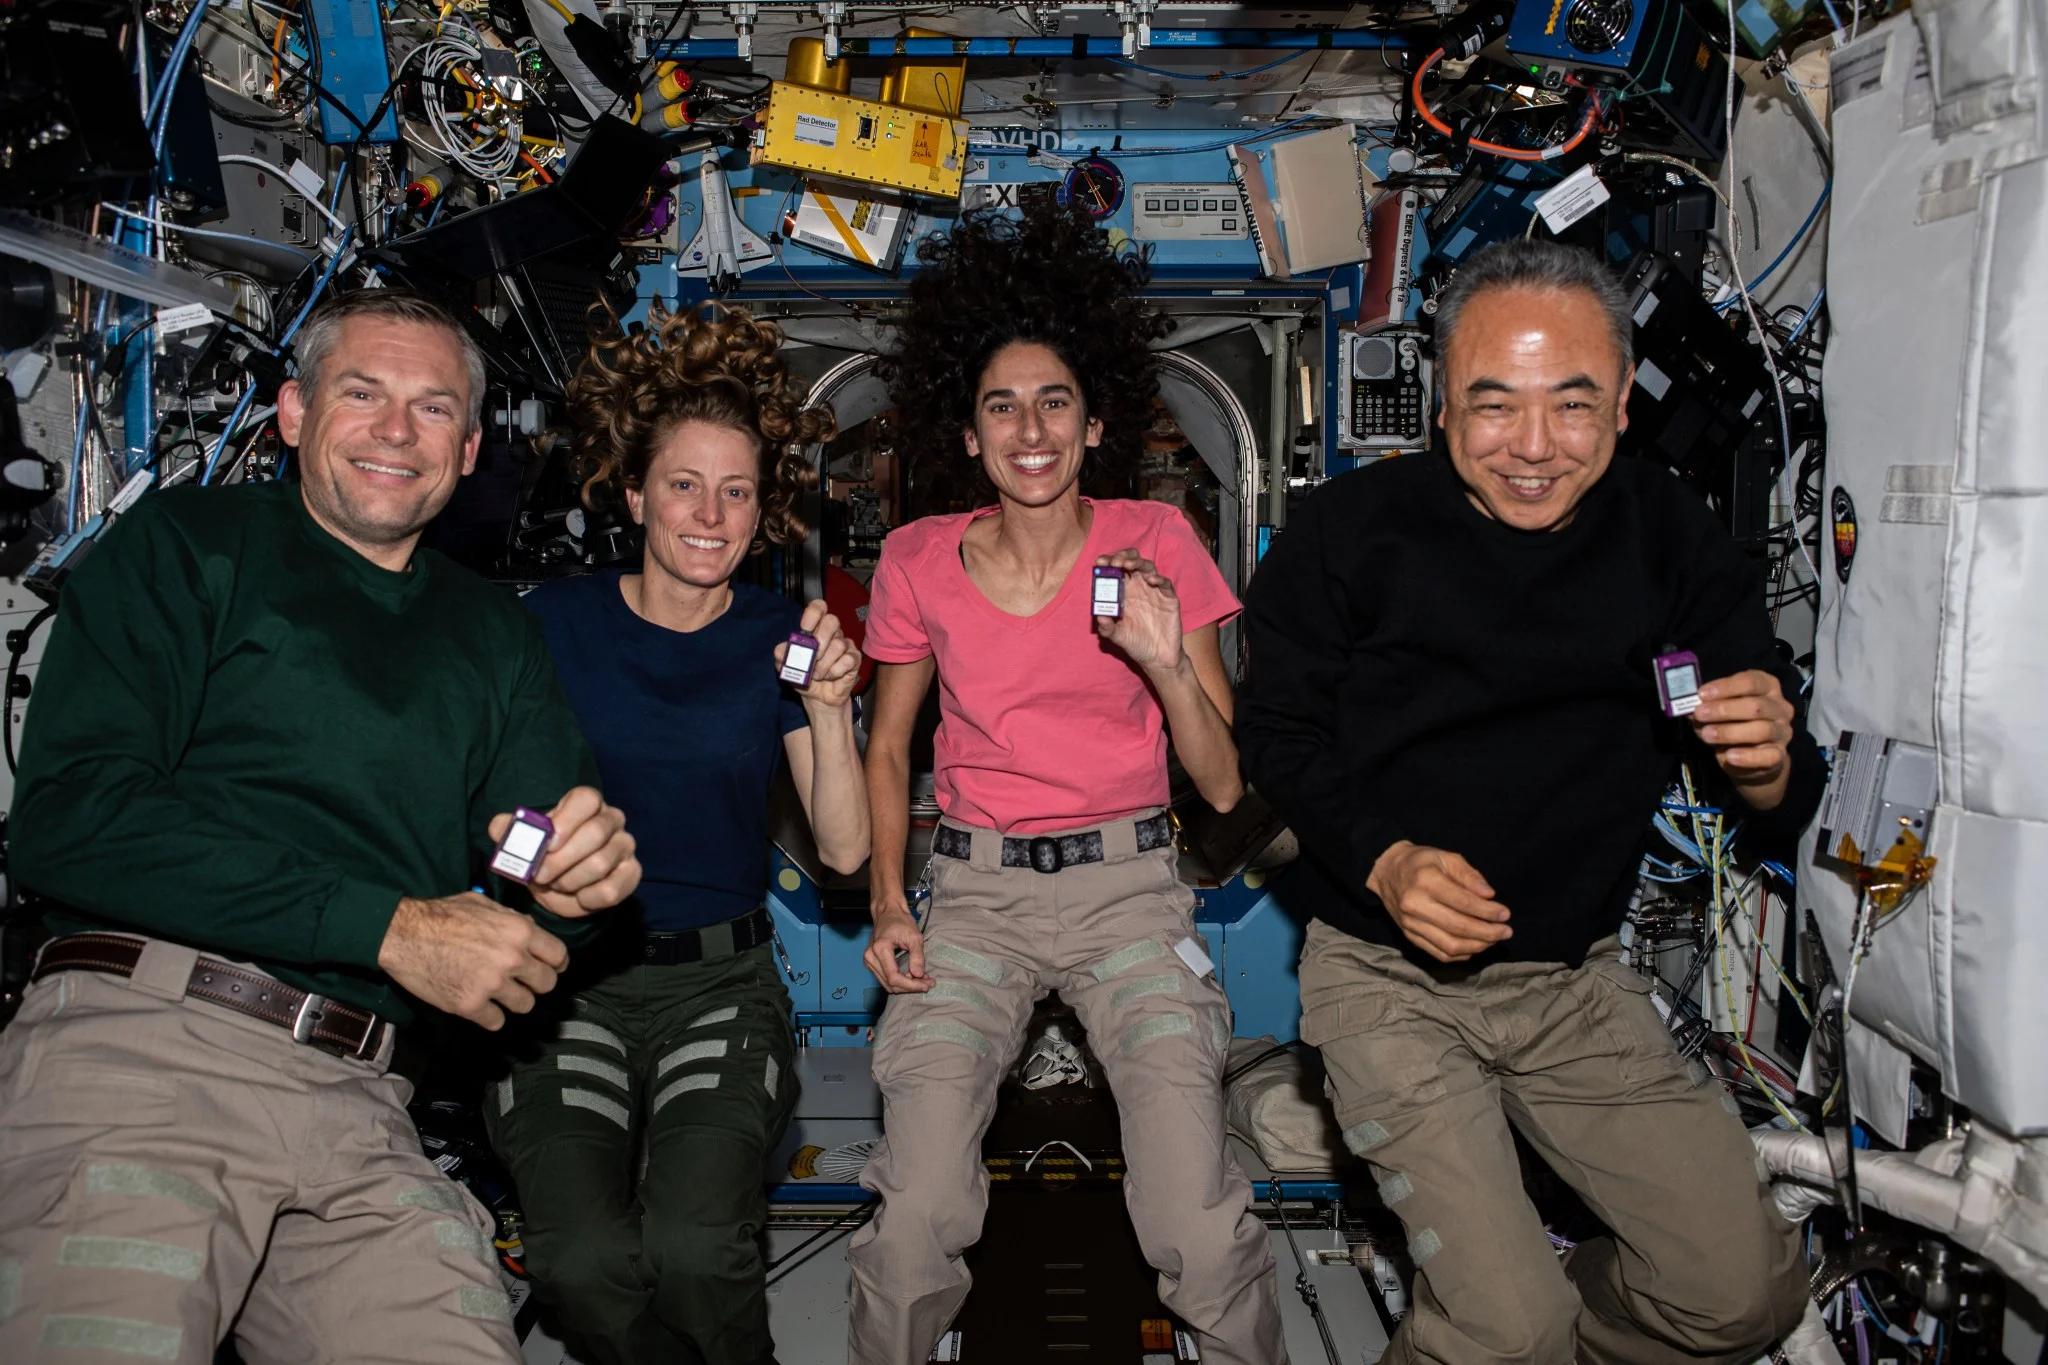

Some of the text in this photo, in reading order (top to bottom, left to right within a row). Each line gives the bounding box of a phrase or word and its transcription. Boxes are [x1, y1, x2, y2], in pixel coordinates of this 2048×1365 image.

[797, 115, 837, 129] Rad Detector
[1237, 177, 1265, 253] WARNING
[1403, 214, 1413, 236] EMER:
[1399, 238, 1410, 267] Depress
[1398, 277, 1406, 291] Fire
[1397, 294, 1405, 302] 1a
